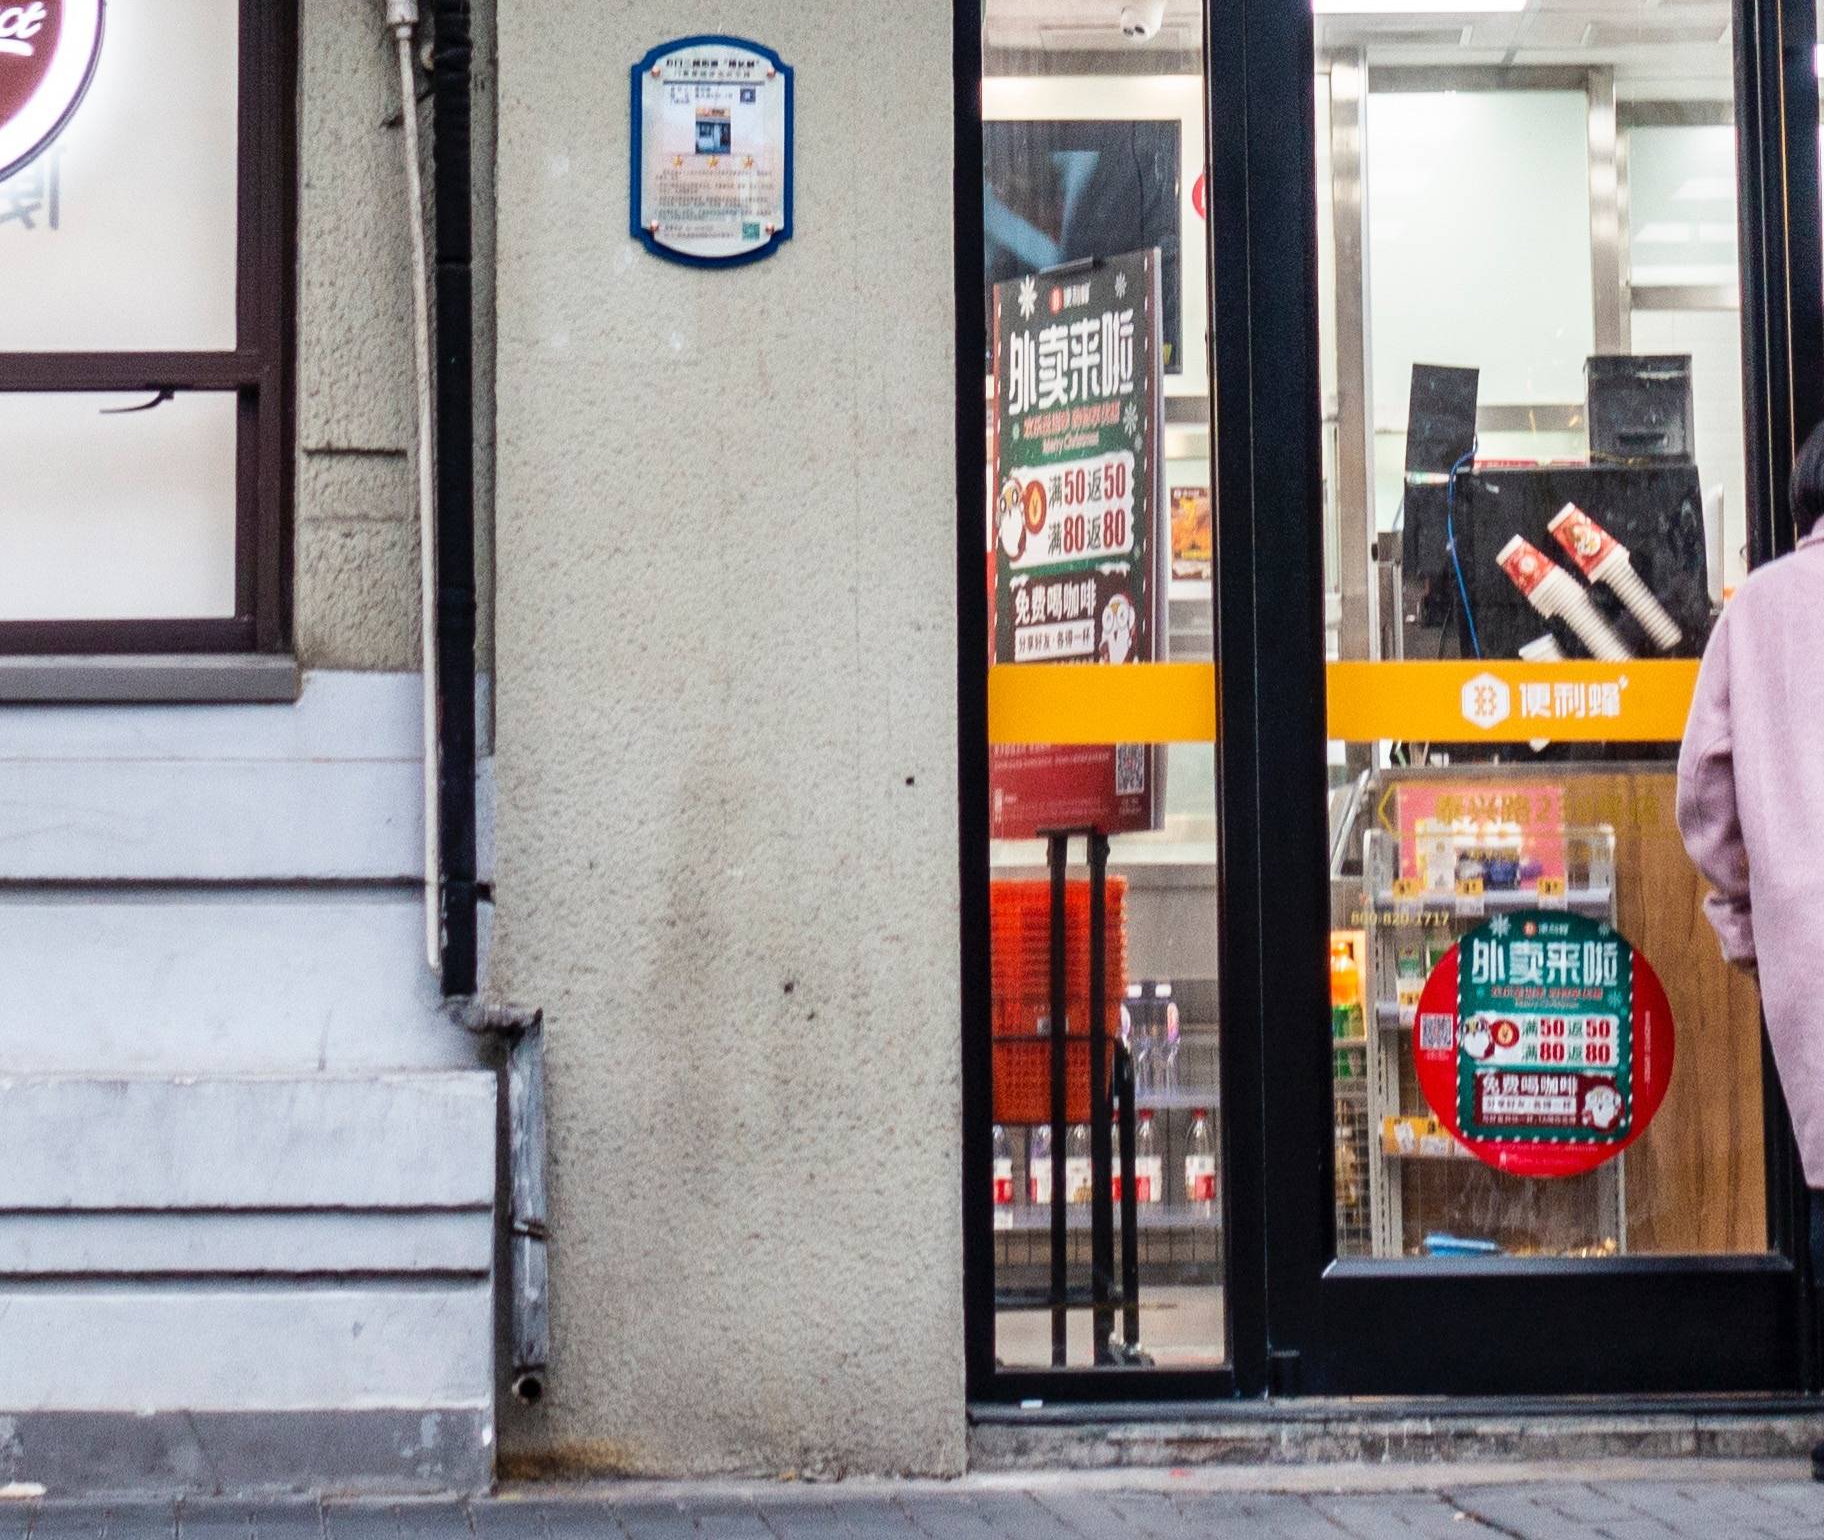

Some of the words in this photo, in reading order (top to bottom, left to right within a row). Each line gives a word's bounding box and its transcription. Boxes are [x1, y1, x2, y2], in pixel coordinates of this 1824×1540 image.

[1009, 308, 1134, 416] 外卖来啦
[1048, 460, 1127, 508] 满50返50
[1047, 507, 1127, 558] 满80返80
[1015, 577, 1097, 626] 免费喝咖啡
[1519, 681, 1621, 718] 便利蜂
[1471, 938, 1619, 987] 外卖来啦
[1521, 1018, 1612, 1038] 满50返50
[1521, 1042, 1612, 1064] 满80返80
